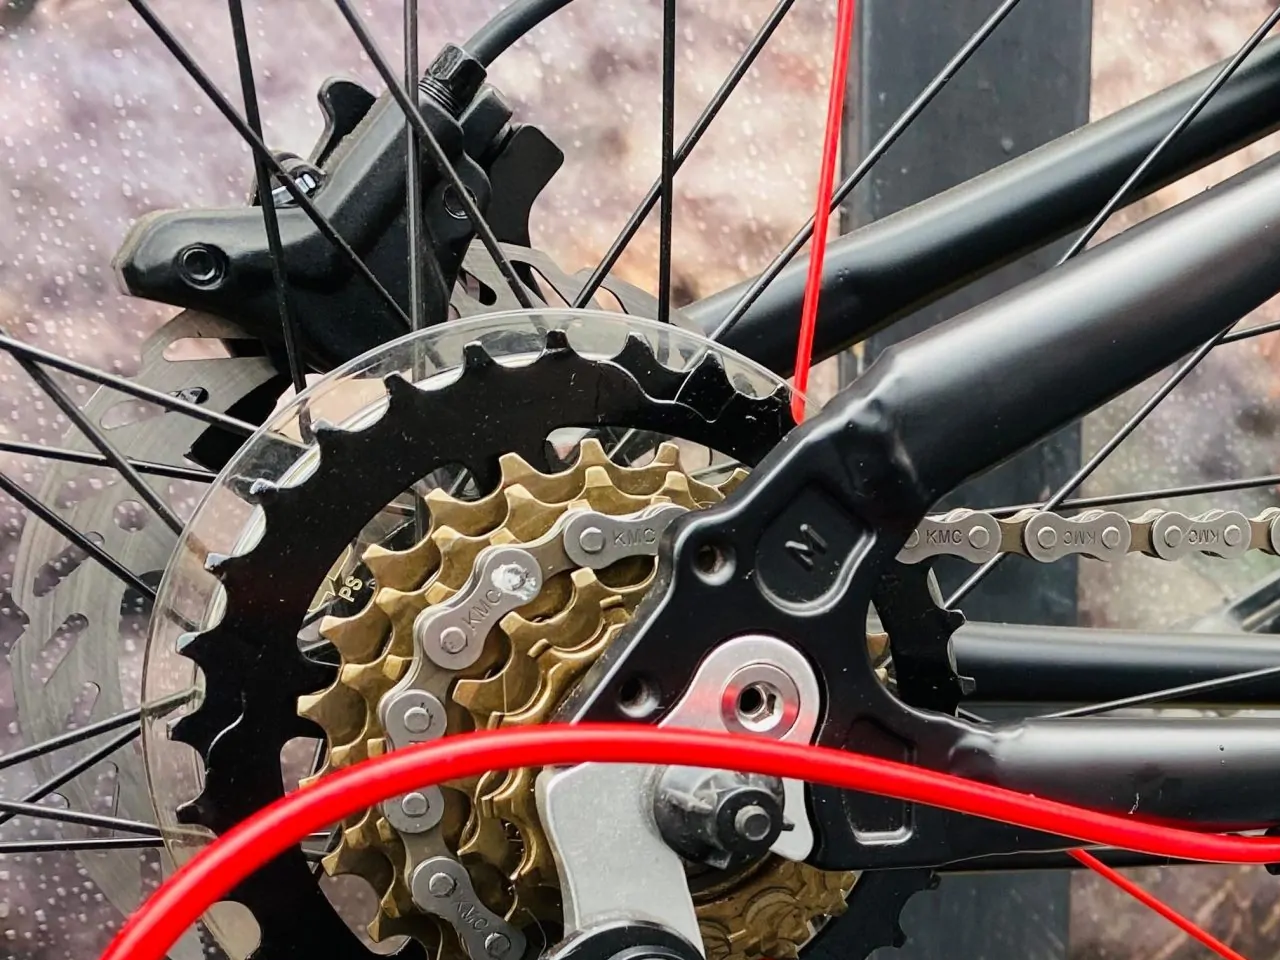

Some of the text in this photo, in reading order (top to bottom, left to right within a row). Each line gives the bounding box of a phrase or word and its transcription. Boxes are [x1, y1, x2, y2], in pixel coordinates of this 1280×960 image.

[612, 526, 656, 548] KMC
[926, 529, 963, 545] KMC
[1063, 530, 1097, 547] KMC
[462, 589, 503, 632] KMC
[453, 898, 489, 932] KMC
